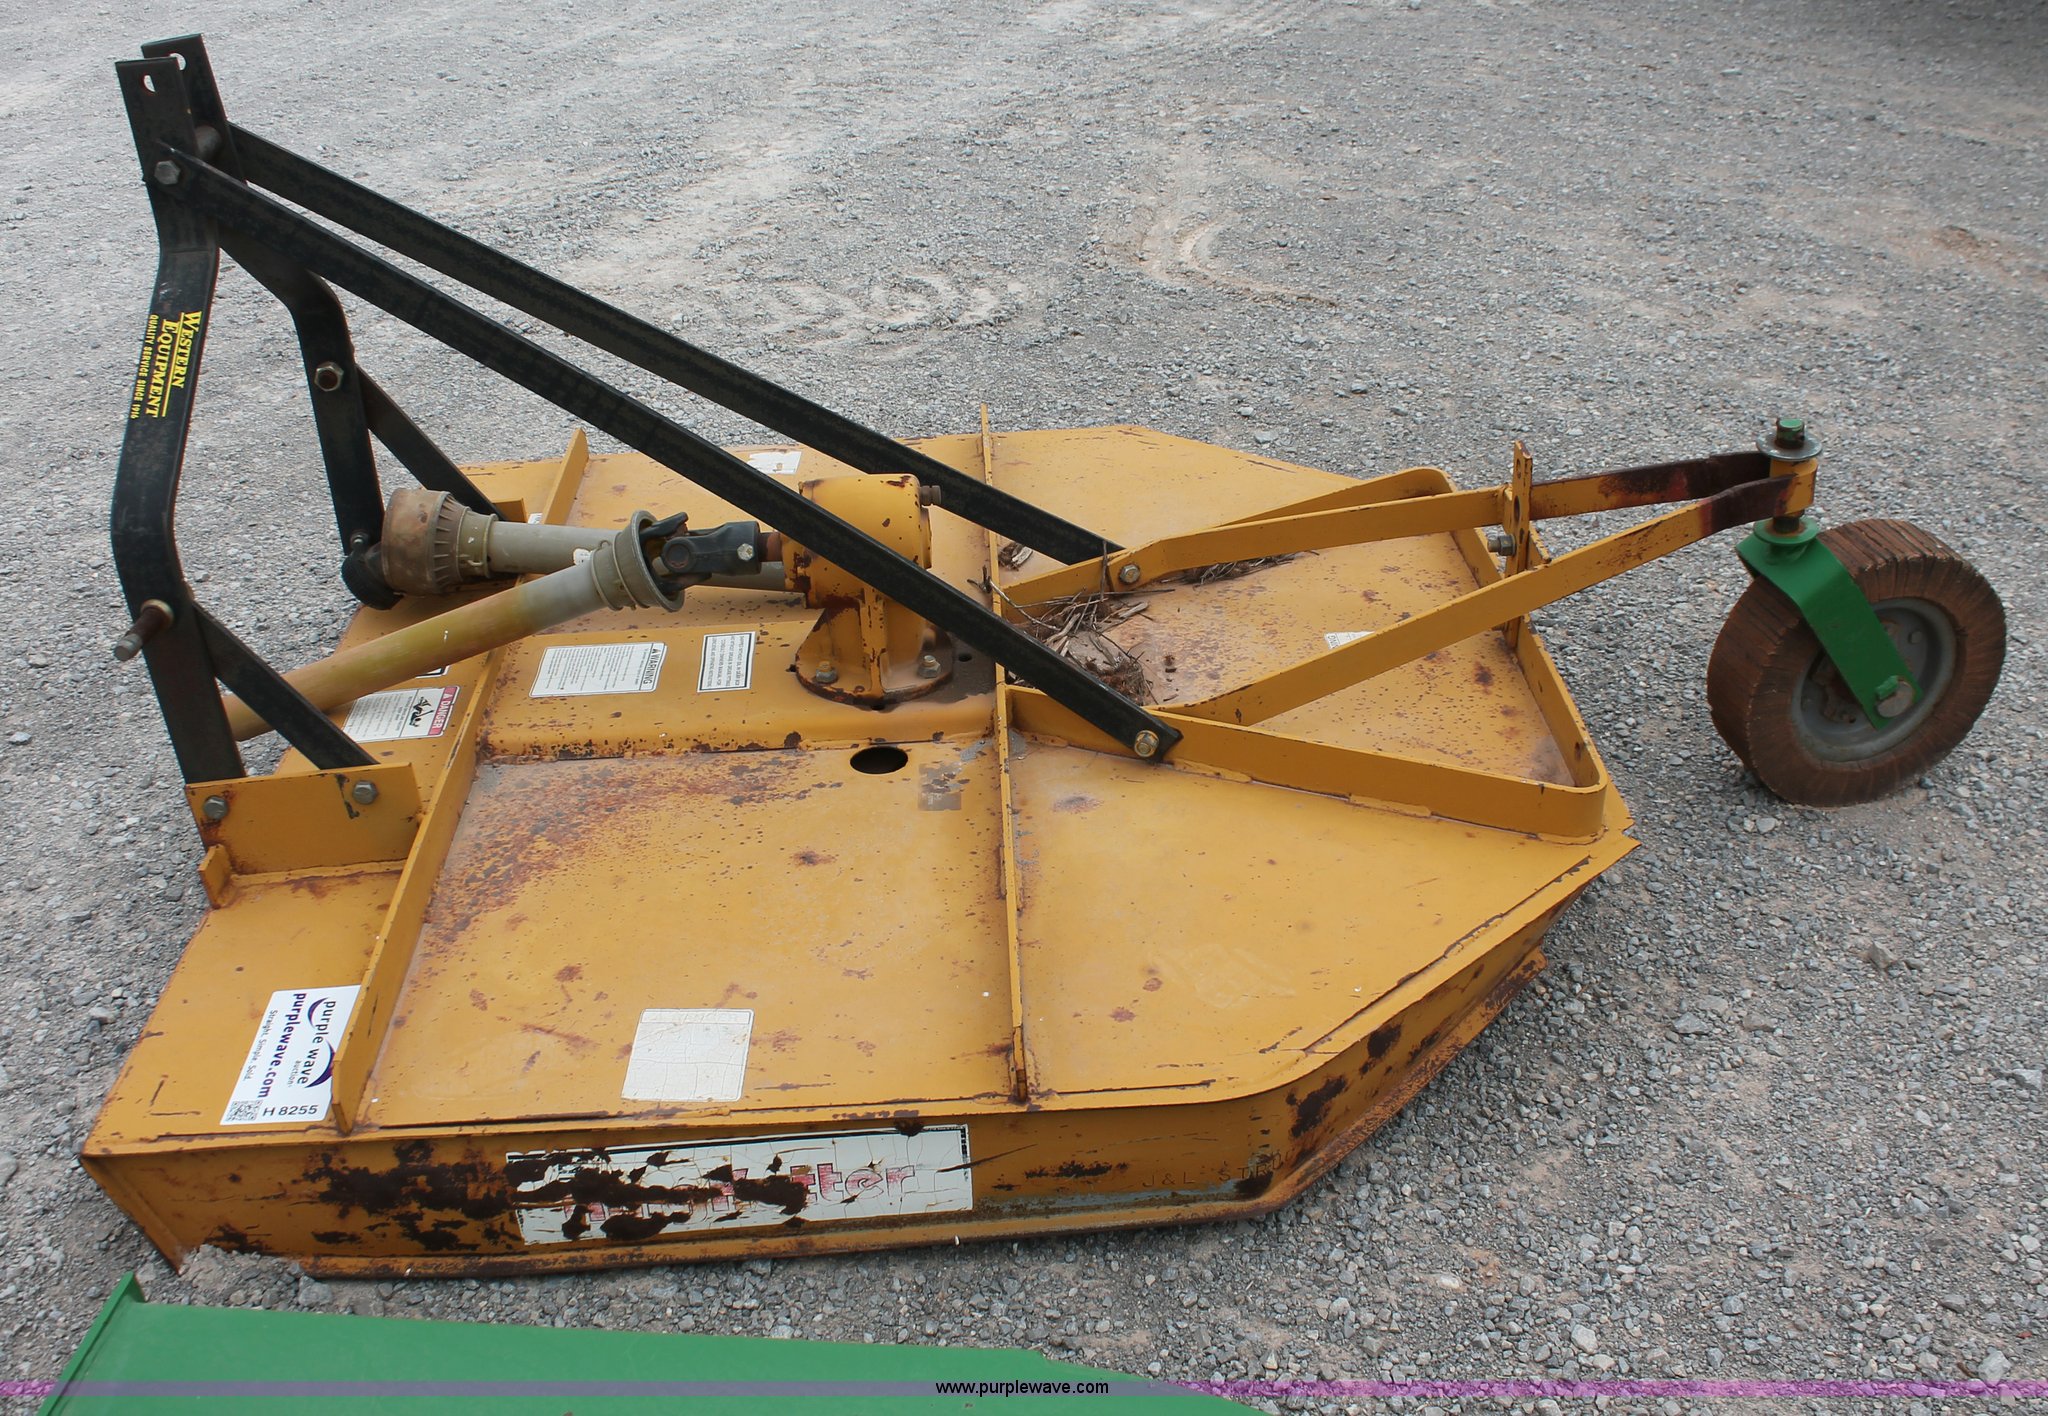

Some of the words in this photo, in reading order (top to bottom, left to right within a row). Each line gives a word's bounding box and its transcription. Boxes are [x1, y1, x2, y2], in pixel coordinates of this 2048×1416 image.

[144, 314, 159, 344] QUALITY
[138, 346, 153, 377] SERVICE
[171, 311, 202, 388] WESTERN
[145, 319, 179, 418] EQUIPMENT
[133, 379, 146, 402] SINCE
[643, 654, 659, 684] WARNING
[432, 700, 451, 729] DANGER
[312, 1001, 336, 1044] purple
[258, 993, 307, 1098] purplewave.com
[287, 1060, 302, 1086] auction
[297, 1048, 320, 1084] wave
[262, 1107, 276, 1117] H
[278, 1105, 319, 1117] 8255
